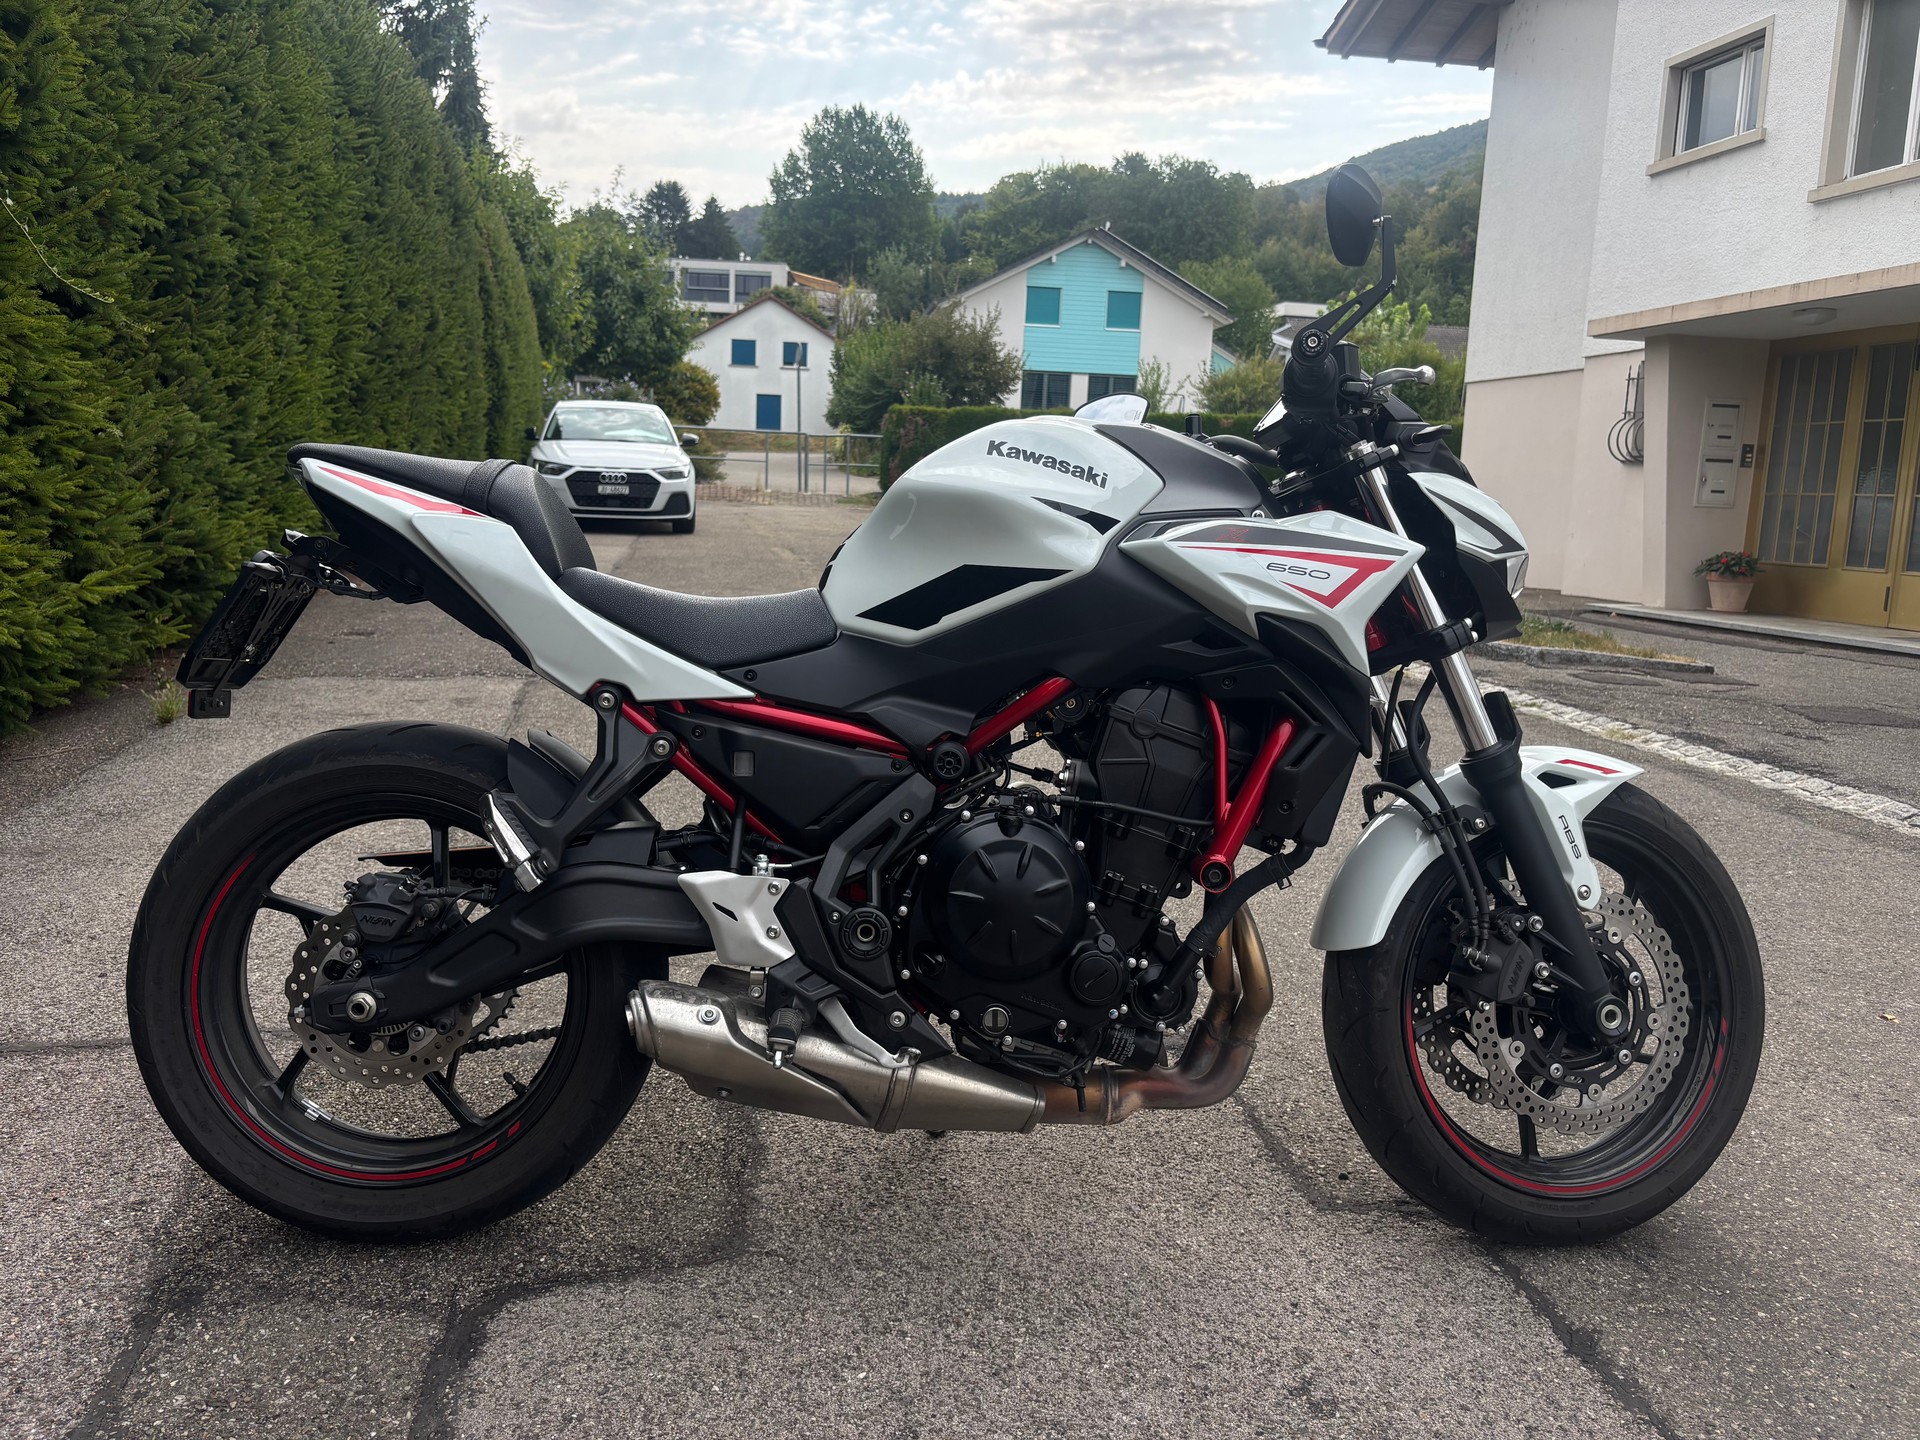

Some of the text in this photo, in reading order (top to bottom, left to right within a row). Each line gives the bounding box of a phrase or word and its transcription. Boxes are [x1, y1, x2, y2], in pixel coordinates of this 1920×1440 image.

[986, 440, 1109, 489] Kawasaki
[1266, 562, 1331, 580] 650
[1558, 814, 1582, 859] ABS
